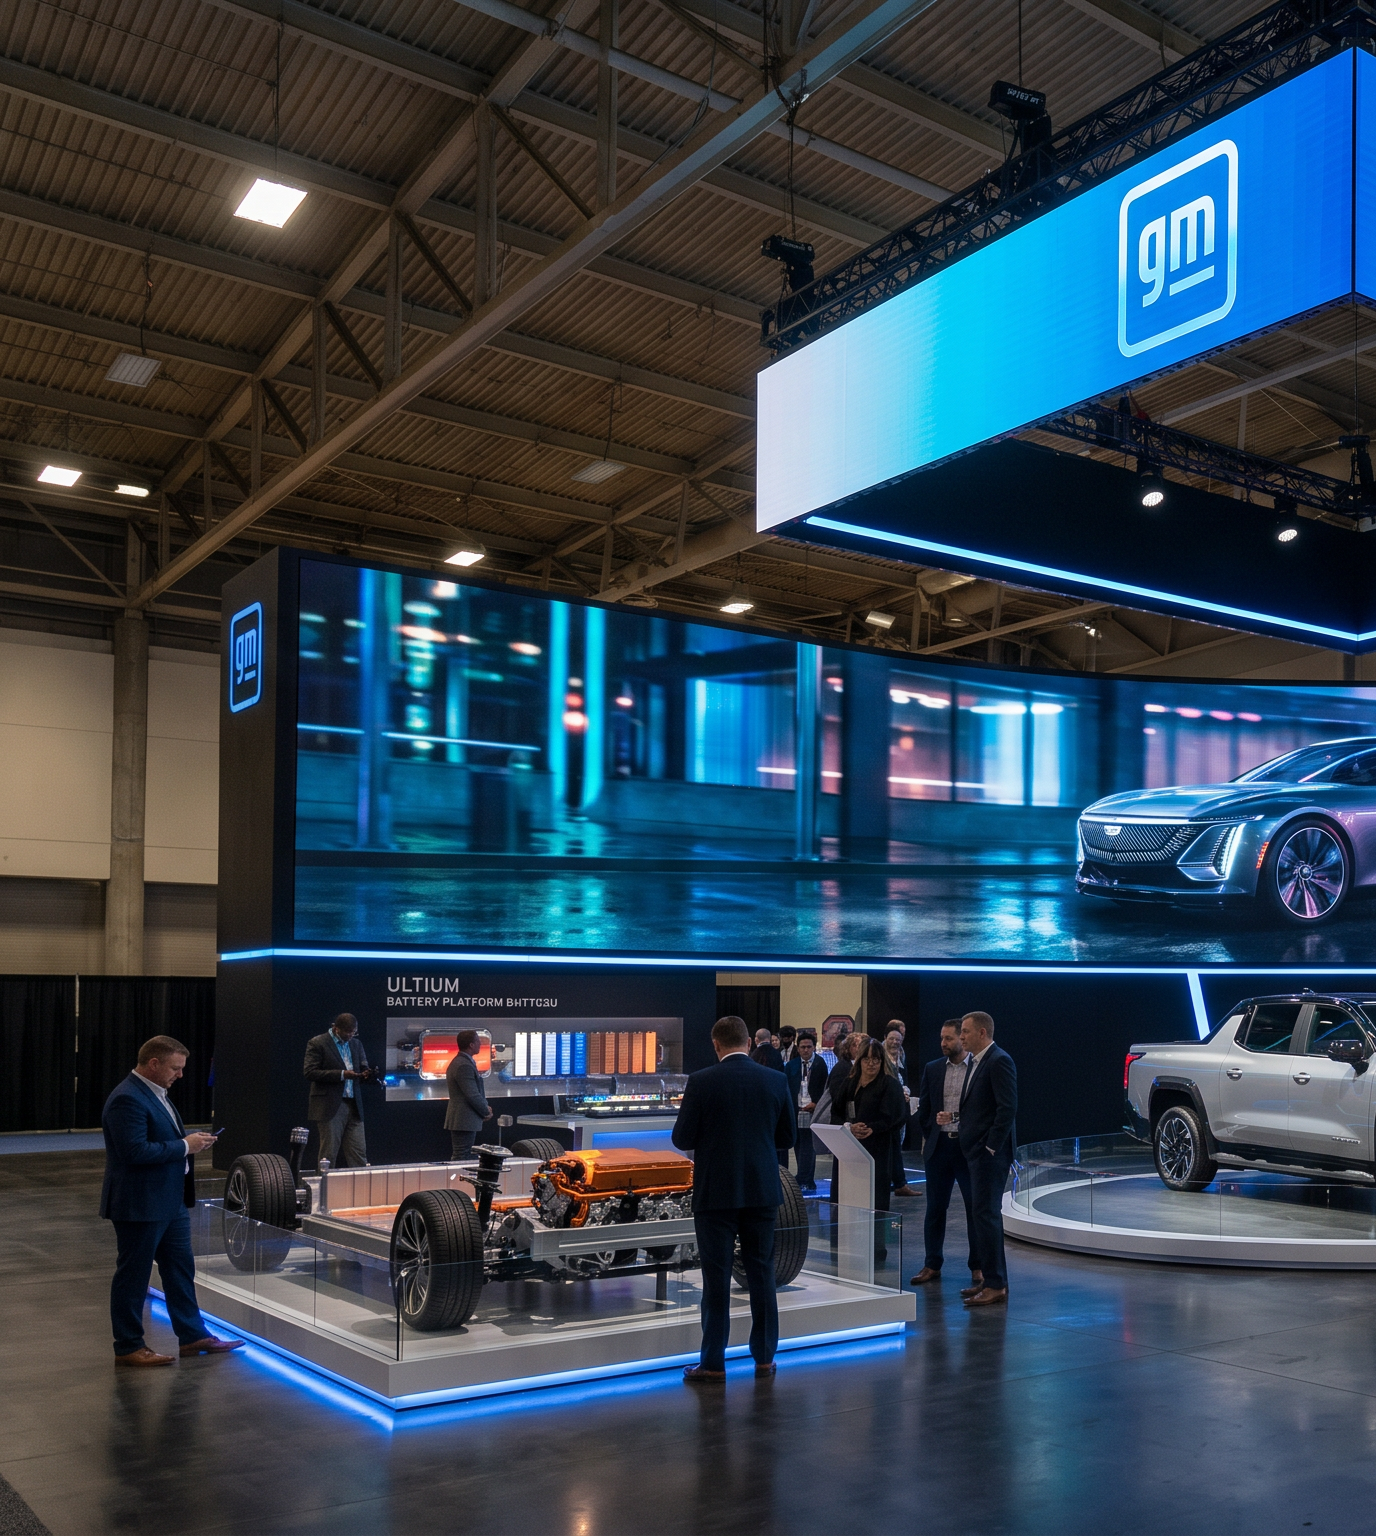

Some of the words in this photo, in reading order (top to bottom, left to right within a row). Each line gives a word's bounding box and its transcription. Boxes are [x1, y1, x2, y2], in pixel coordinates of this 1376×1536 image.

[1138, 195, 1215, 308] gm
[235, 628, 257, 685] gm
[386, 996, 440, 1007] BATTERY
[442, 997, 503, 1007] PLATFORM
[387, 976, 460, 993] ULTIUM
